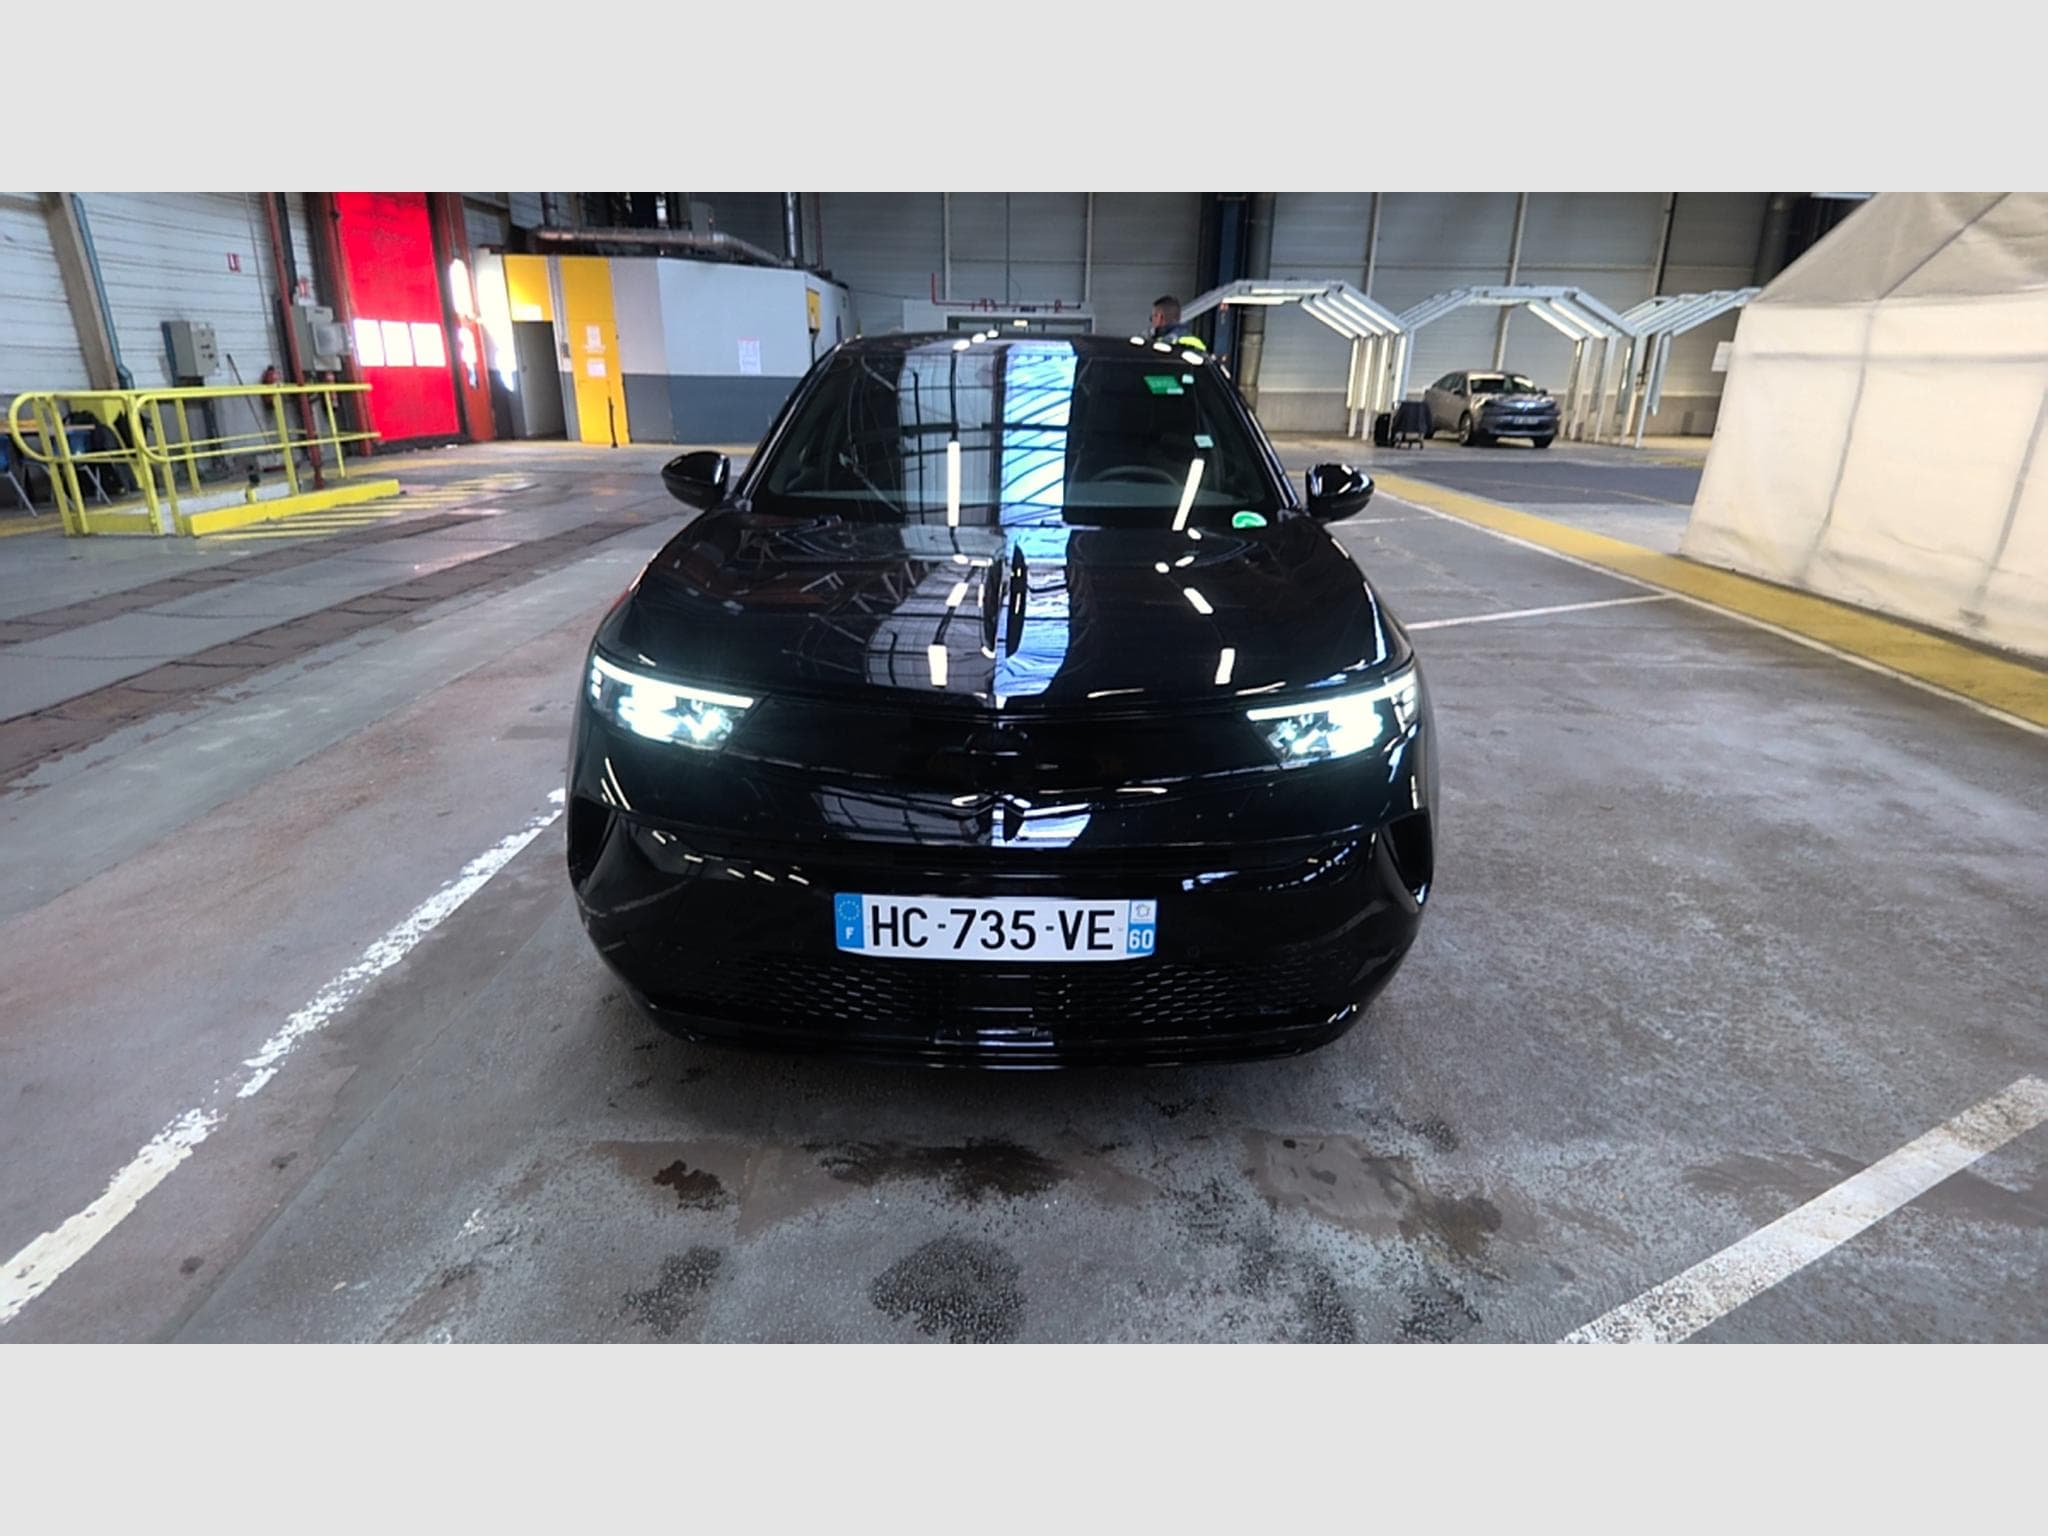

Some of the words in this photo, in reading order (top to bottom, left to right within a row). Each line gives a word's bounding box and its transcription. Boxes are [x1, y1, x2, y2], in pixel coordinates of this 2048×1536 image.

[845, 926, 855, 940] F
[871, 904, 1116, 951] HC-735-VE
[1128, 928, 1154, 950] 60
